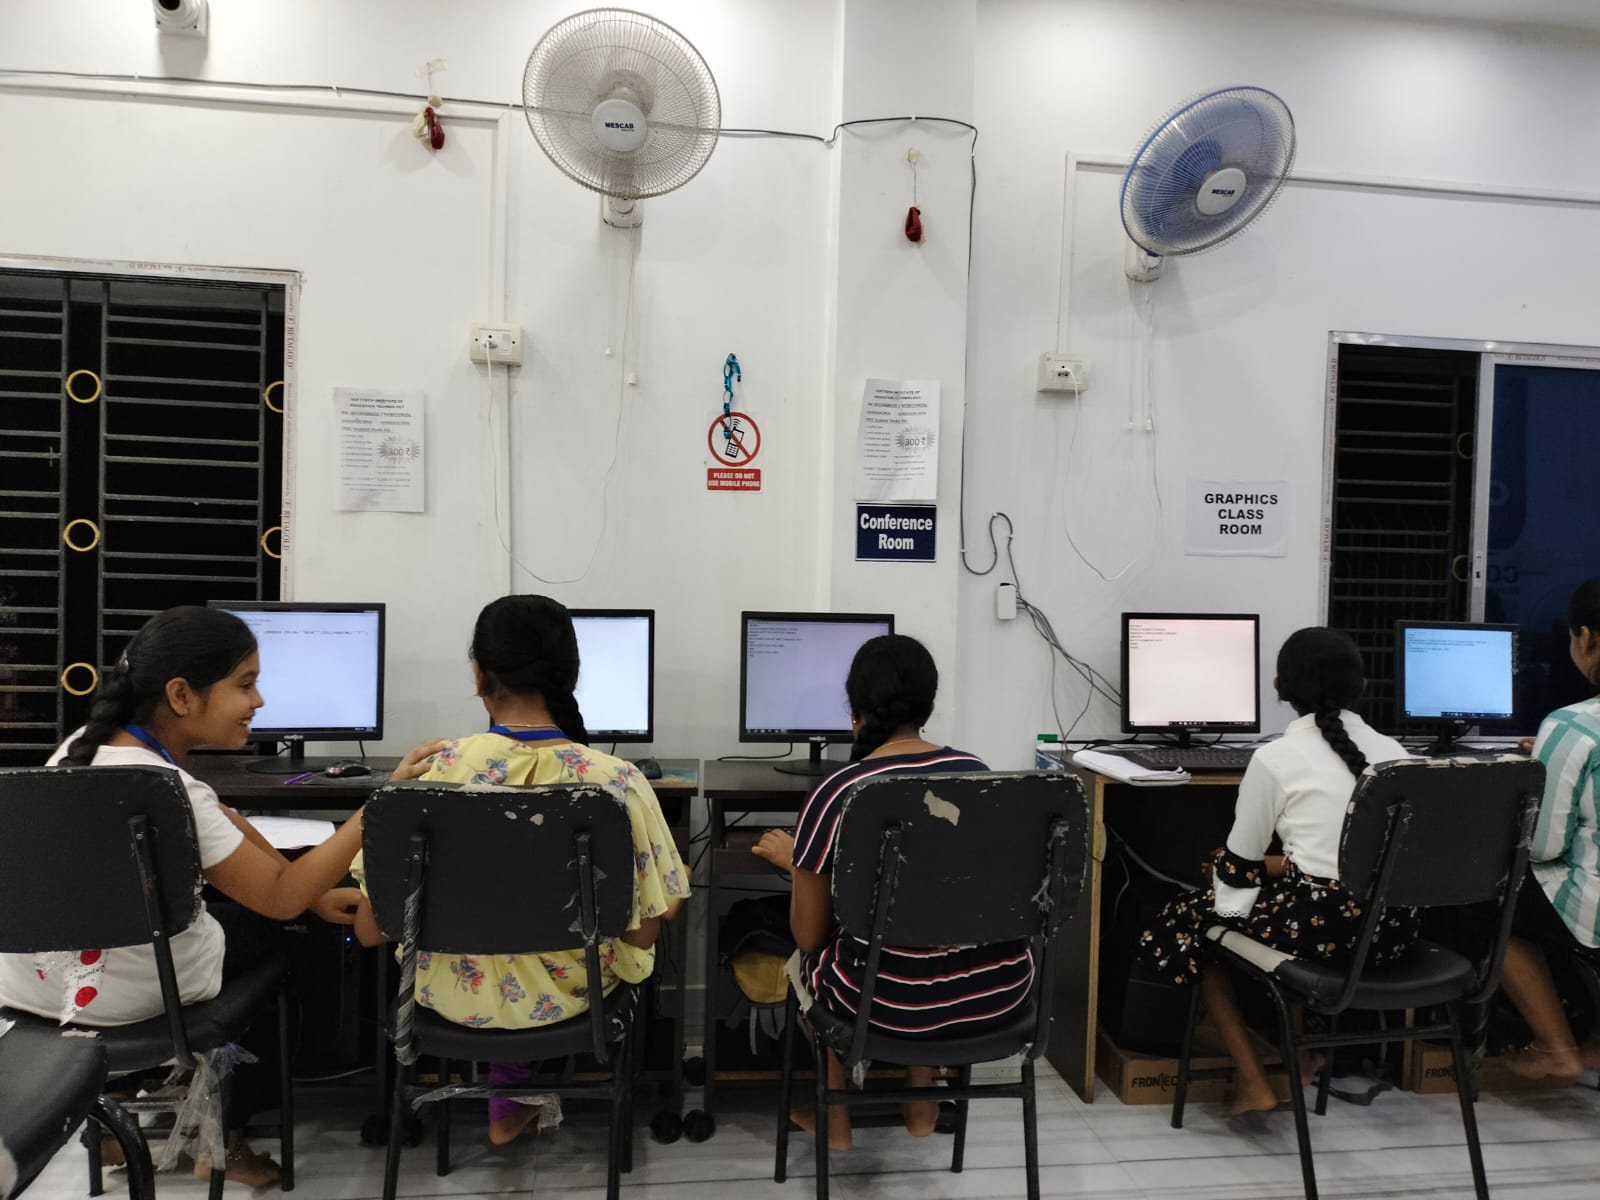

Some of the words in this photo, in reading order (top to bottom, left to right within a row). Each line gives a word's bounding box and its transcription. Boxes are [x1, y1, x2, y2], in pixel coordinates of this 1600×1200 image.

[744, 472, 755, 480] NOT
[1204, 493, 1279, 505] GRAPHICS
[1217, 508, 1264, 520] CLASS
[860, 513, 933, 531] Conference
[1219, 523, 1262, 535] ROOM
[878, 533, 914, 550] Room
[1131, 1072, 1180, 1092] FRONTEC
